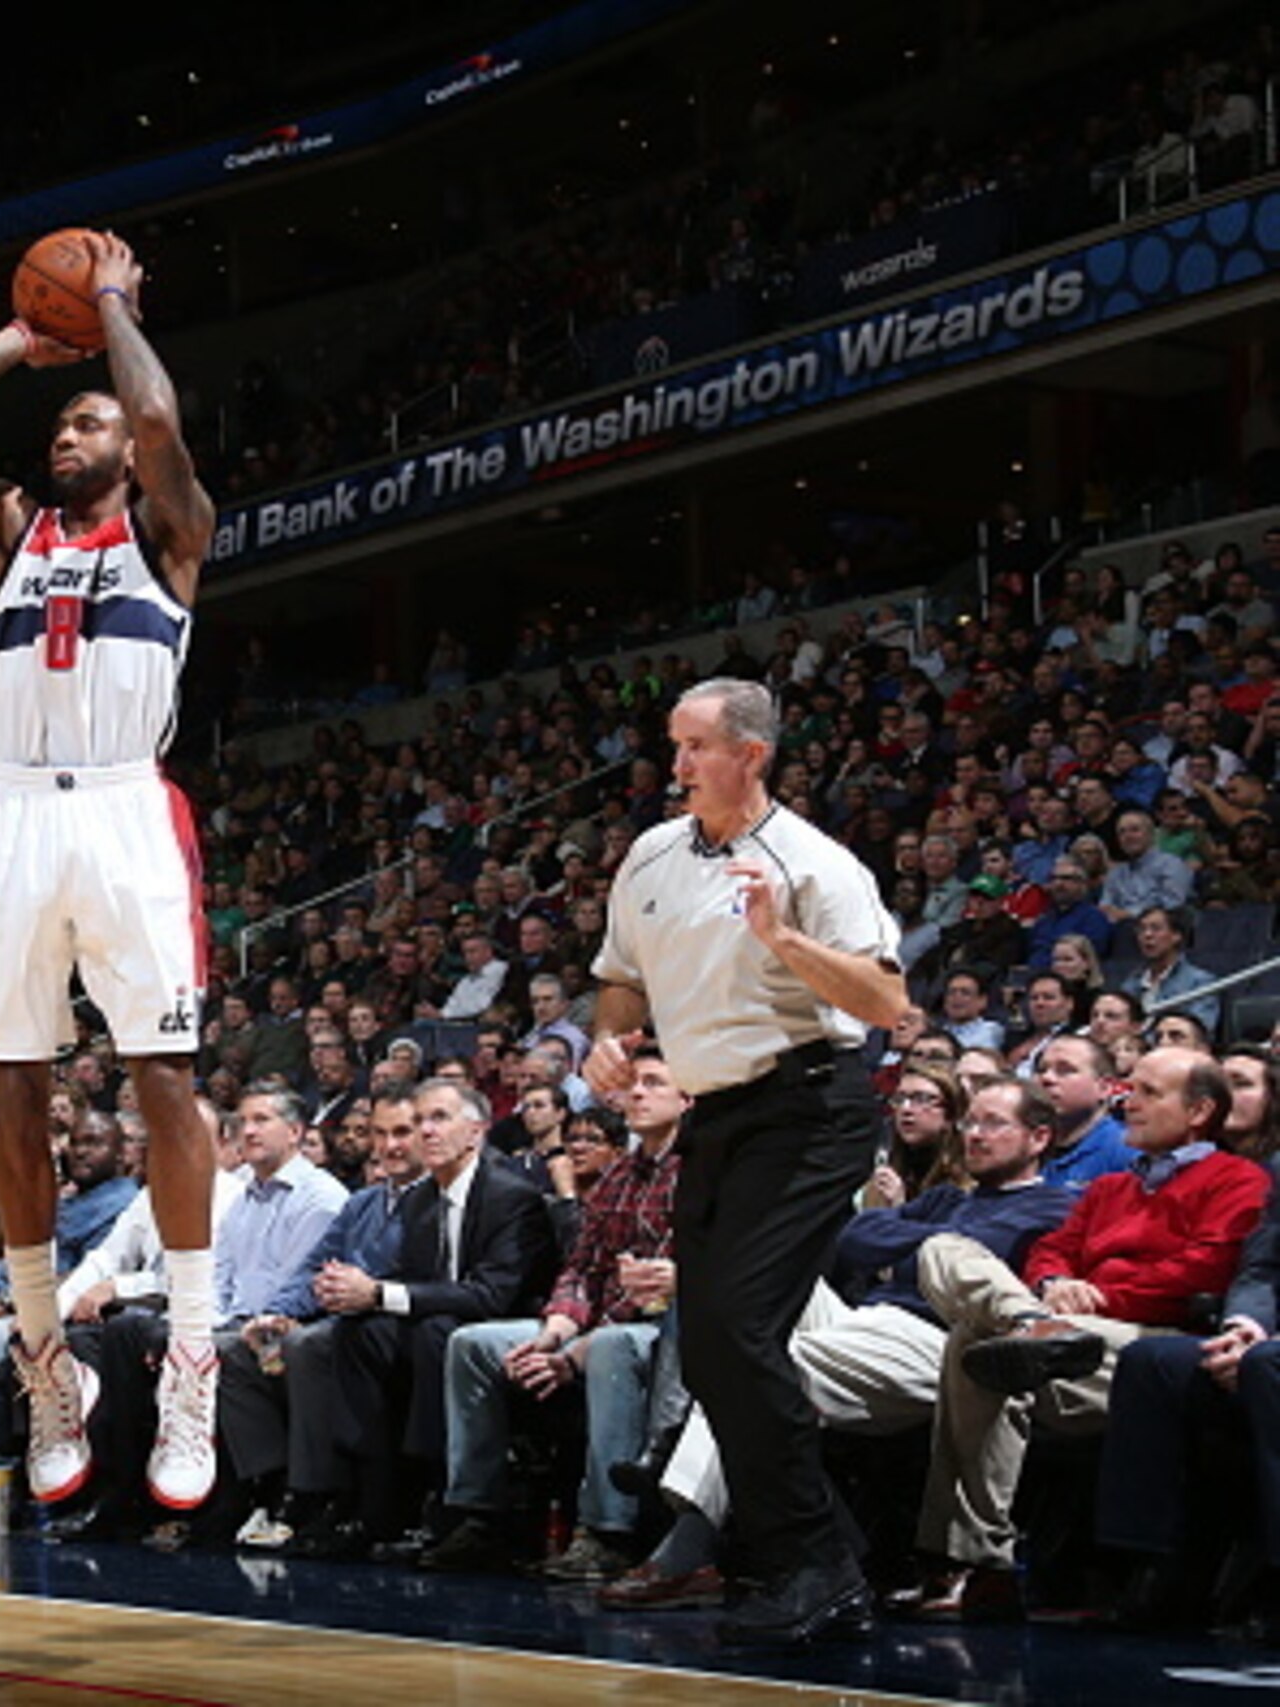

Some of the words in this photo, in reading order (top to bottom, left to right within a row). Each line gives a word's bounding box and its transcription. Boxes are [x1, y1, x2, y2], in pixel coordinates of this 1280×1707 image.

[257, 481, 360, 547] Bank
[370, 460, 417, 515] of
[425, 445, 507, 497] The
[521, 350, 820, 470] Washington
[838, 266, 1085, 377] Wizards
[45, 596, 81, 671] 8
